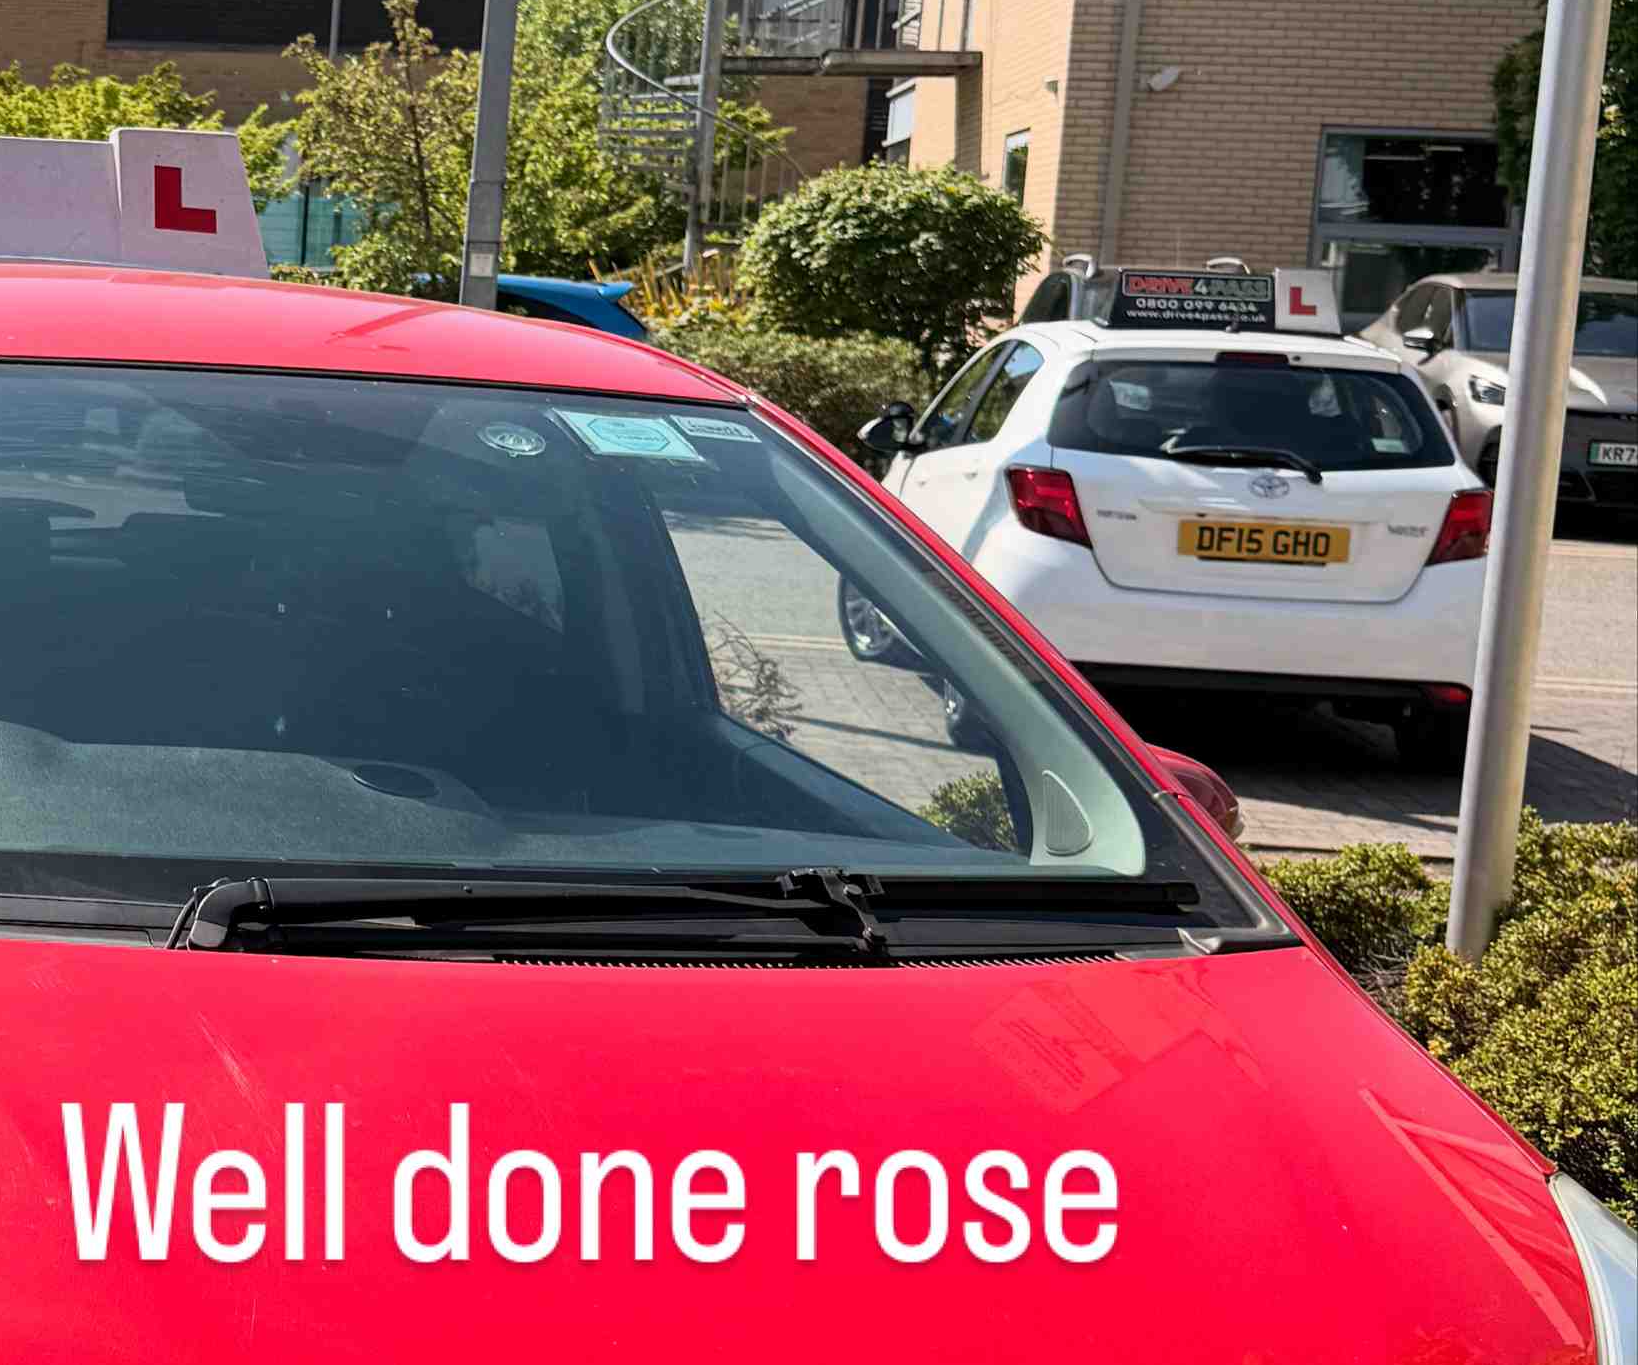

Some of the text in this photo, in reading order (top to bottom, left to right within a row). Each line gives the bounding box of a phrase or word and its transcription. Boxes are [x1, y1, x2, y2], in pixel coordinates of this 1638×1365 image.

[154, 165, 218, 234] L
[1136, 298, 1179, 310] 0800
[1183, 299, 1215, 311] 099
[1289, 286, 1317, 316] L
[1196, 525, 1331, 557] DF15 GHO
